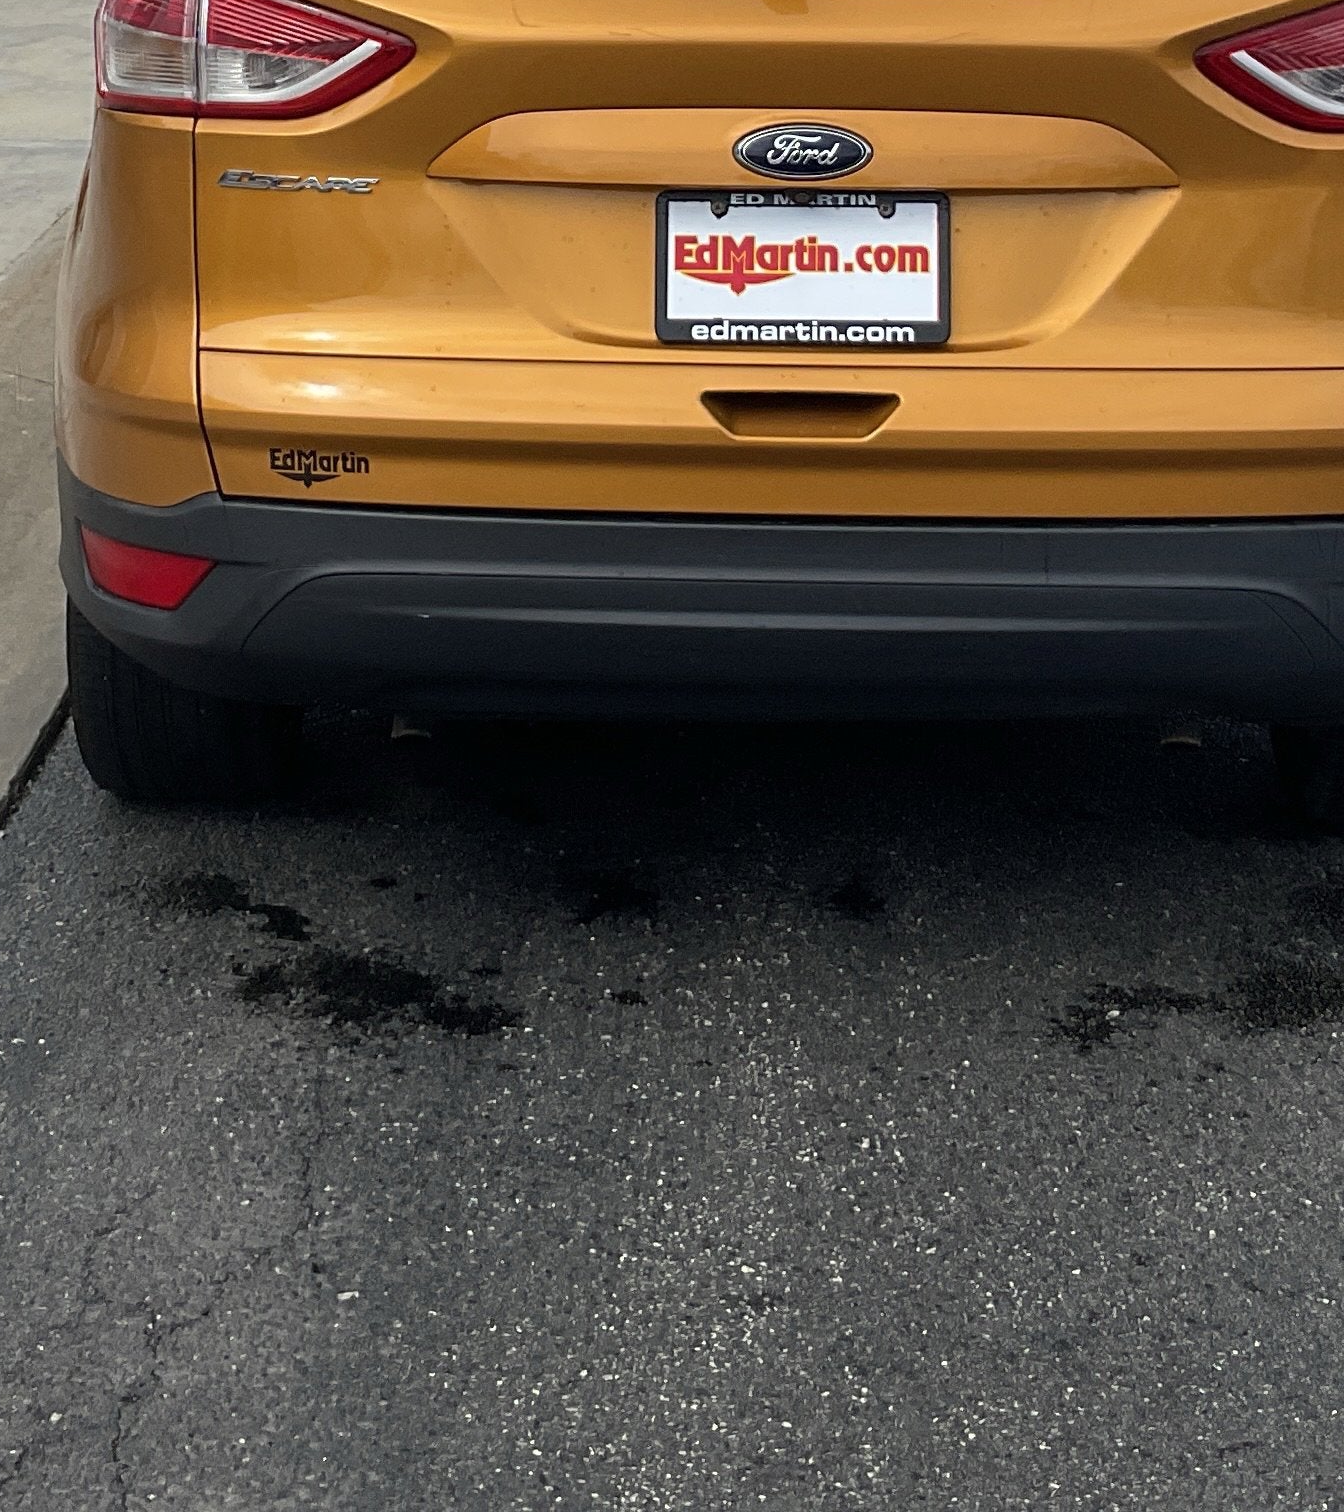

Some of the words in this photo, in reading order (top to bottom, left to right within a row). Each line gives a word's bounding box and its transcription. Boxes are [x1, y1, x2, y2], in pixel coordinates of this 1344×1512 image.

[766, 133, 840, 166] Ford
[730, 193, 764, 205] ED
[773, 193, 877, 206] MRTIN
[674, 235, 930, 274] EdMartin.com
[691, 320, 915, 342] edmartin.com
[269, 447, 370, 474] EdMartin
